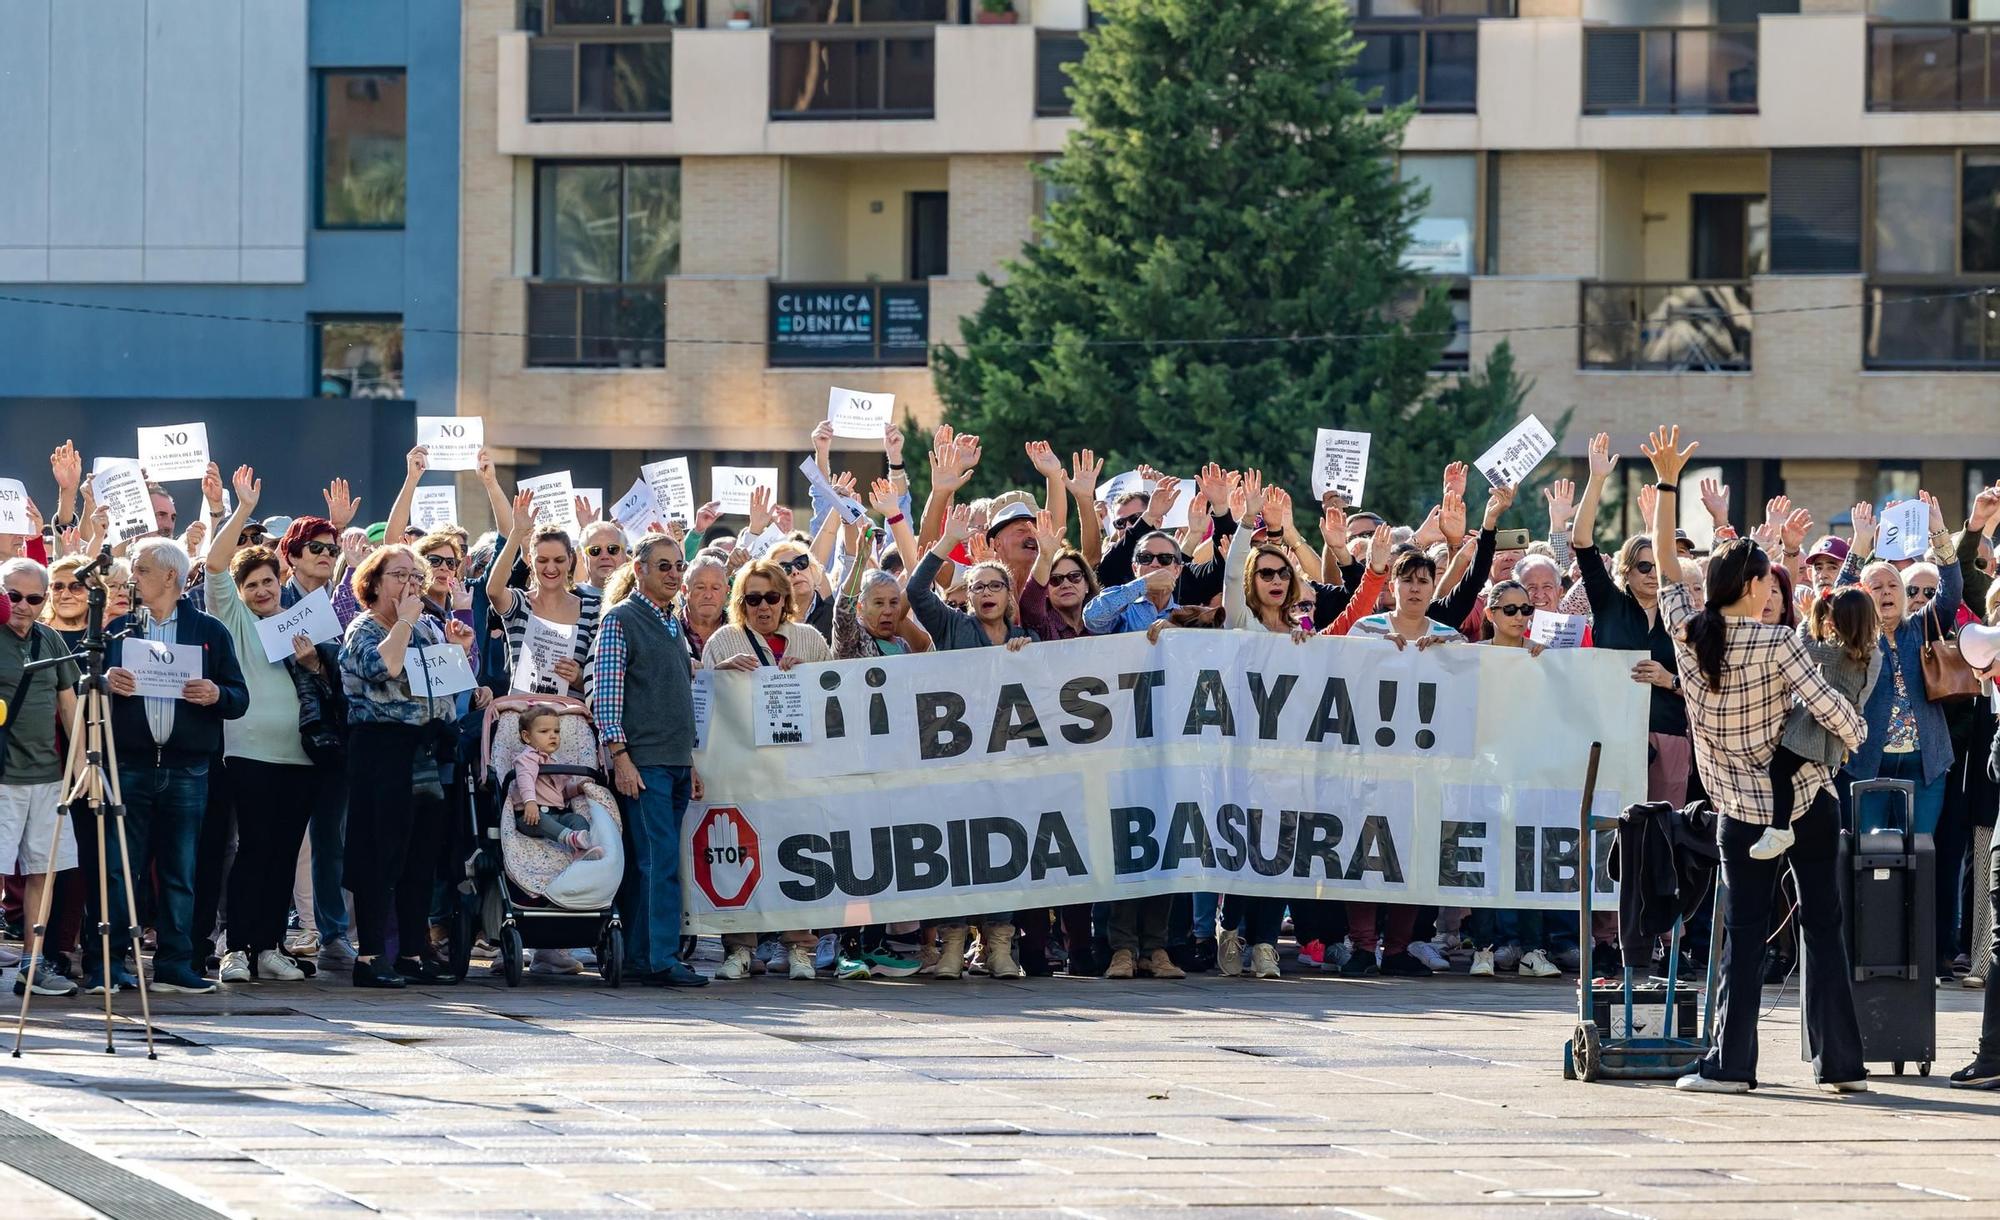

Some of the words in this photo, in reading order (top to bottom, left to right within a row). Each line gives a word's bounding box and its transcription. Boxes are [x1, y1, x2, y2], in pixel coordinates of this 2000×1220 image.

[792, 314, 871, 332] DENTAL
[850, 398, 872, 411] NO
[164, 431, 188, 447] NO
[440, 424, 464, 438] NO
[734, 474, 756, 486] NO
[3, 510, 15, 521] YA
[1886, 526, 1899, 545] NO
[277, 607, 313, 633] BASTA
[148, 648, 174, 664] NO
[703, 847, 749, 867] STOP
[777, 811, 1088, 901] SUBIDA
[1110, 801, 1404, 883] BASURA
[1438, 820, 1487, 888] E
[1515, 825, 1615, 894] IBI
